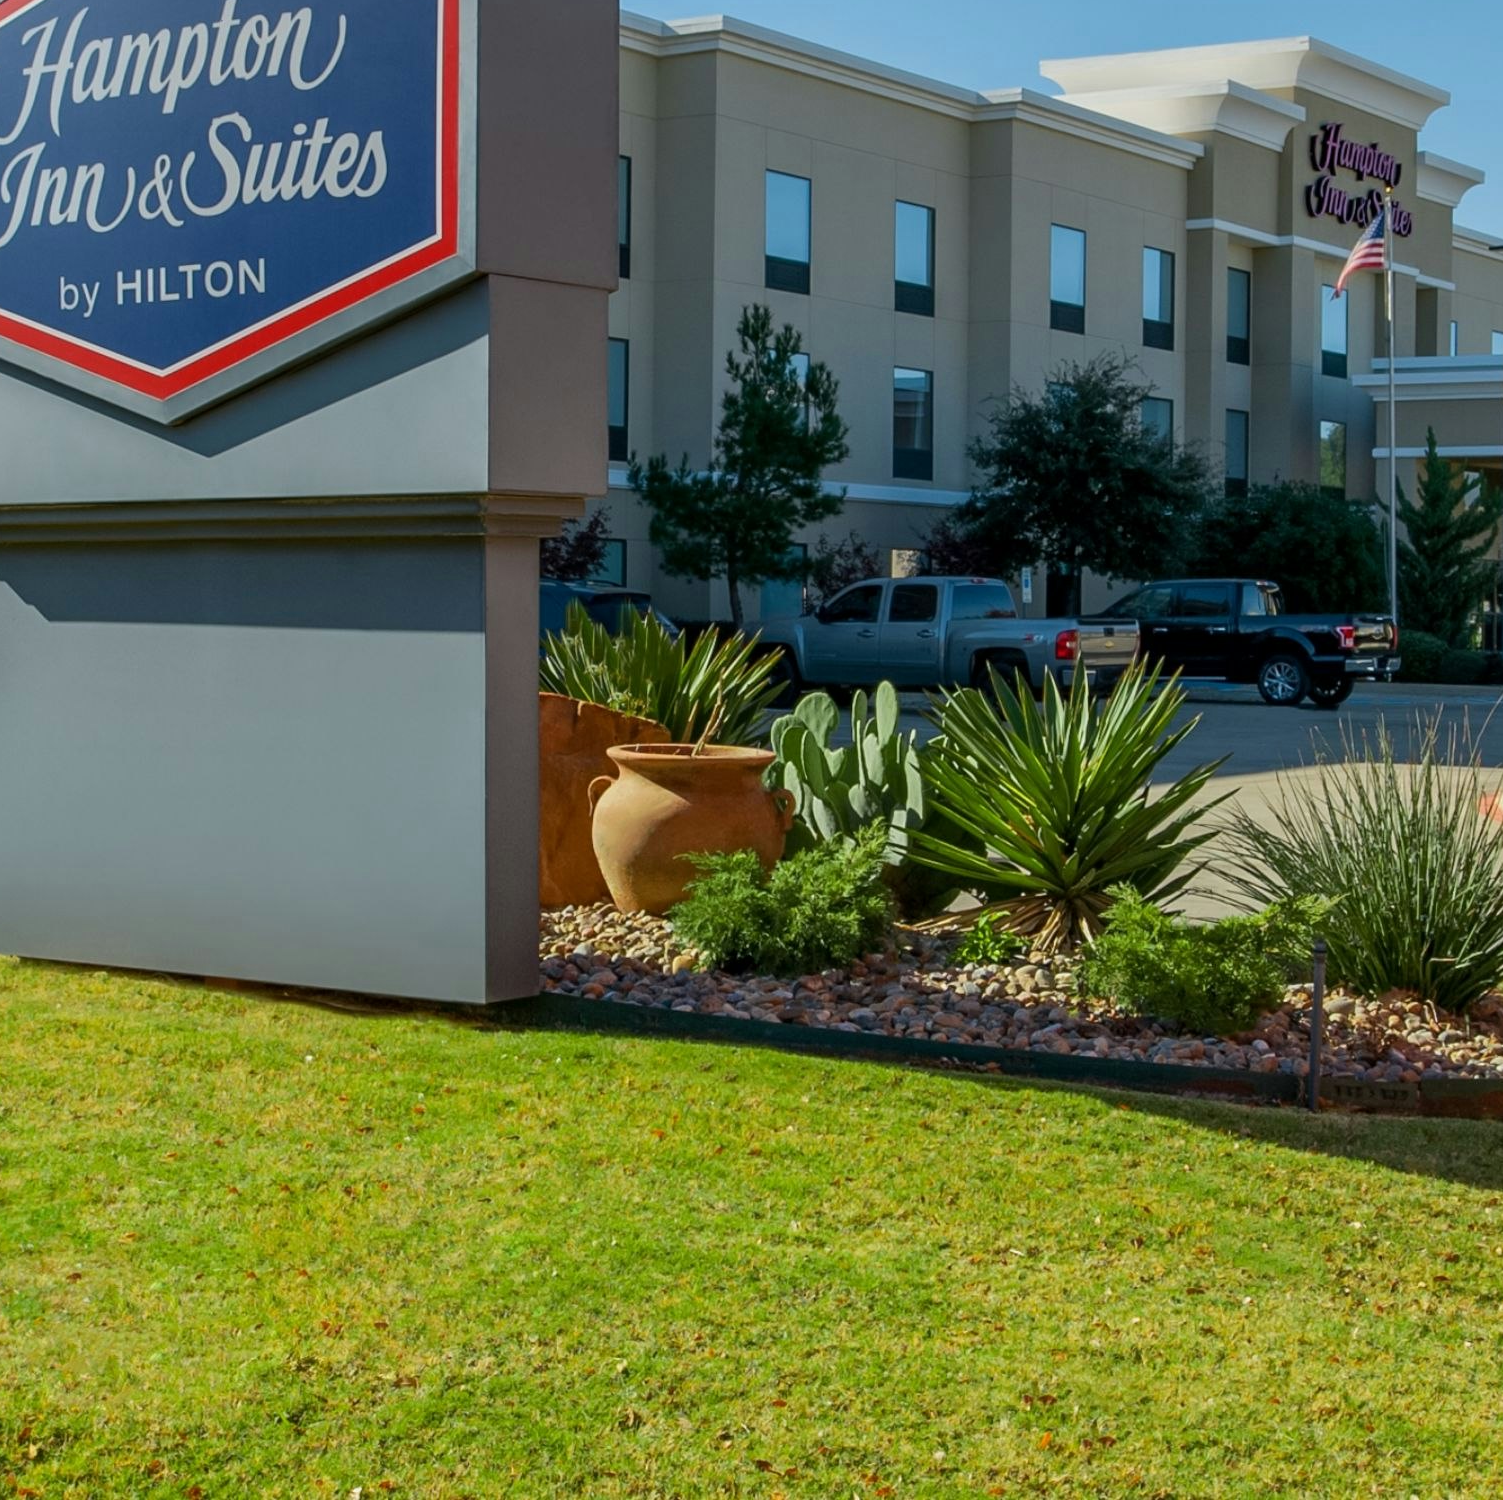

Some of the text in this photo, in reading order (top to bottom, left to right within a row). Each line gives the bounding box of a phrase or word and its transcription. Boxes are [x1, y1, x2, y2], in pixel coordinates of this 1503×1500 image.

[180, 111, 388, 217] Suites
[1310, 122, 1401, 186] Hampton
[1305, 175, 1357, 223] Inn
[58, 257, 267, 318] by HILTON
